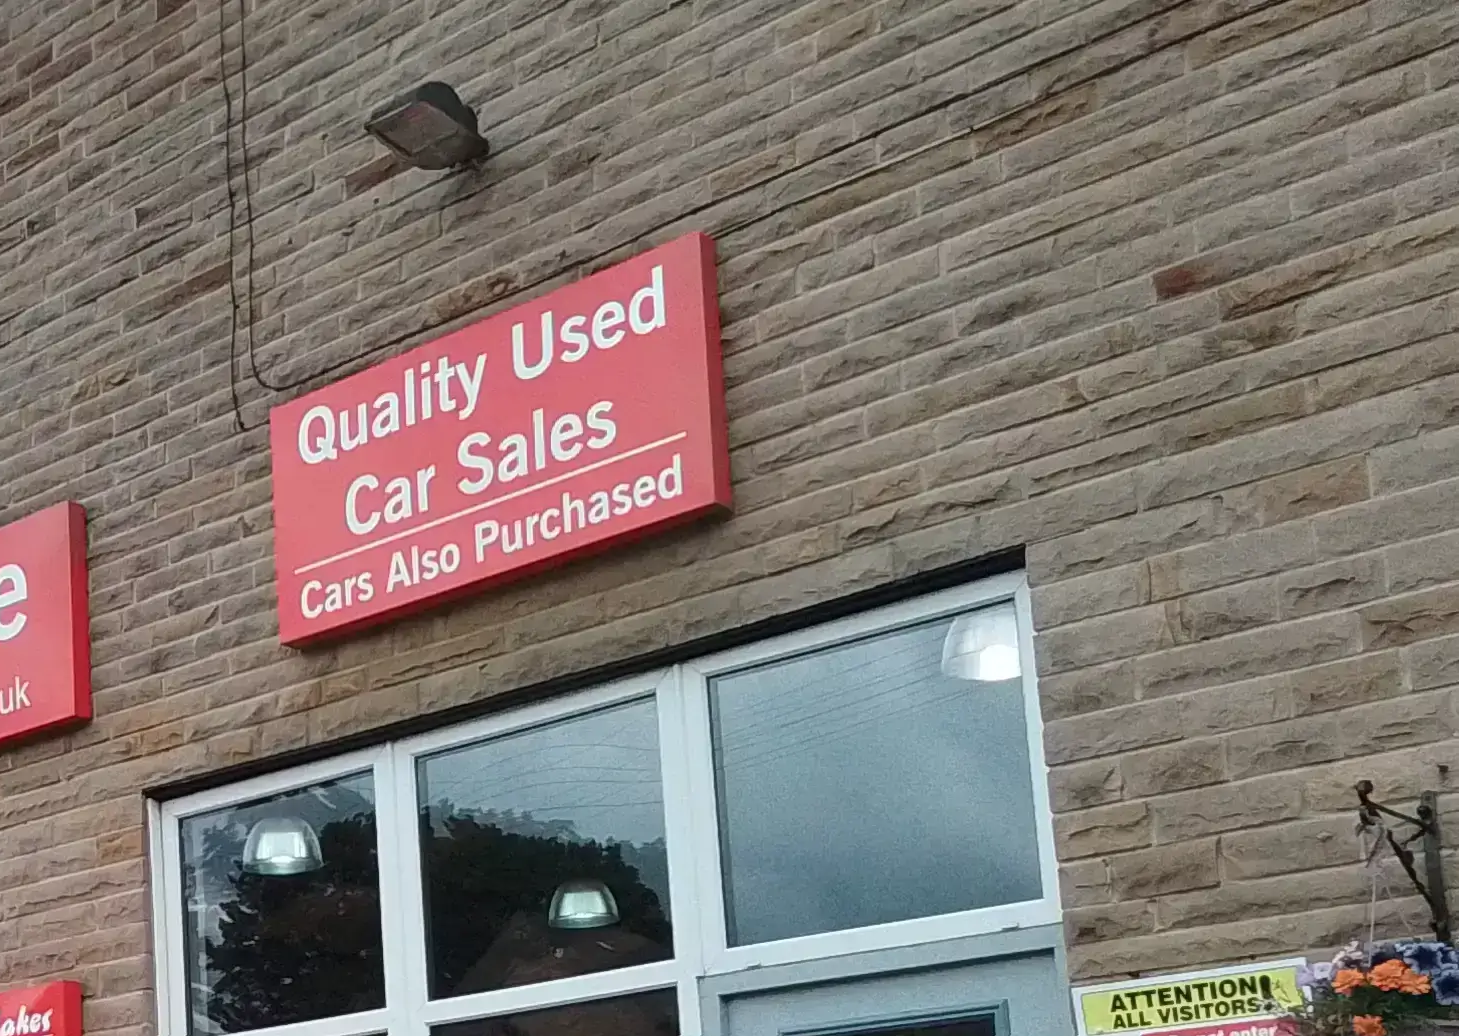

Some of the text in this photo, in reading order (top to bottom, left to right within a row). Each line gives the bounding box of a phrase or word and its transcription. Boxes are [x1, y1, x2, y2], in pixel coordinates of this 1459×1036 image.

[297, 265, 666, 464] Quality Used
[300, 454, 684, 618] Cars Also Purchased
[344, 400, 616, 535] Car Sales
[1113, 998, 1261, 1029] ALL VISITORS
